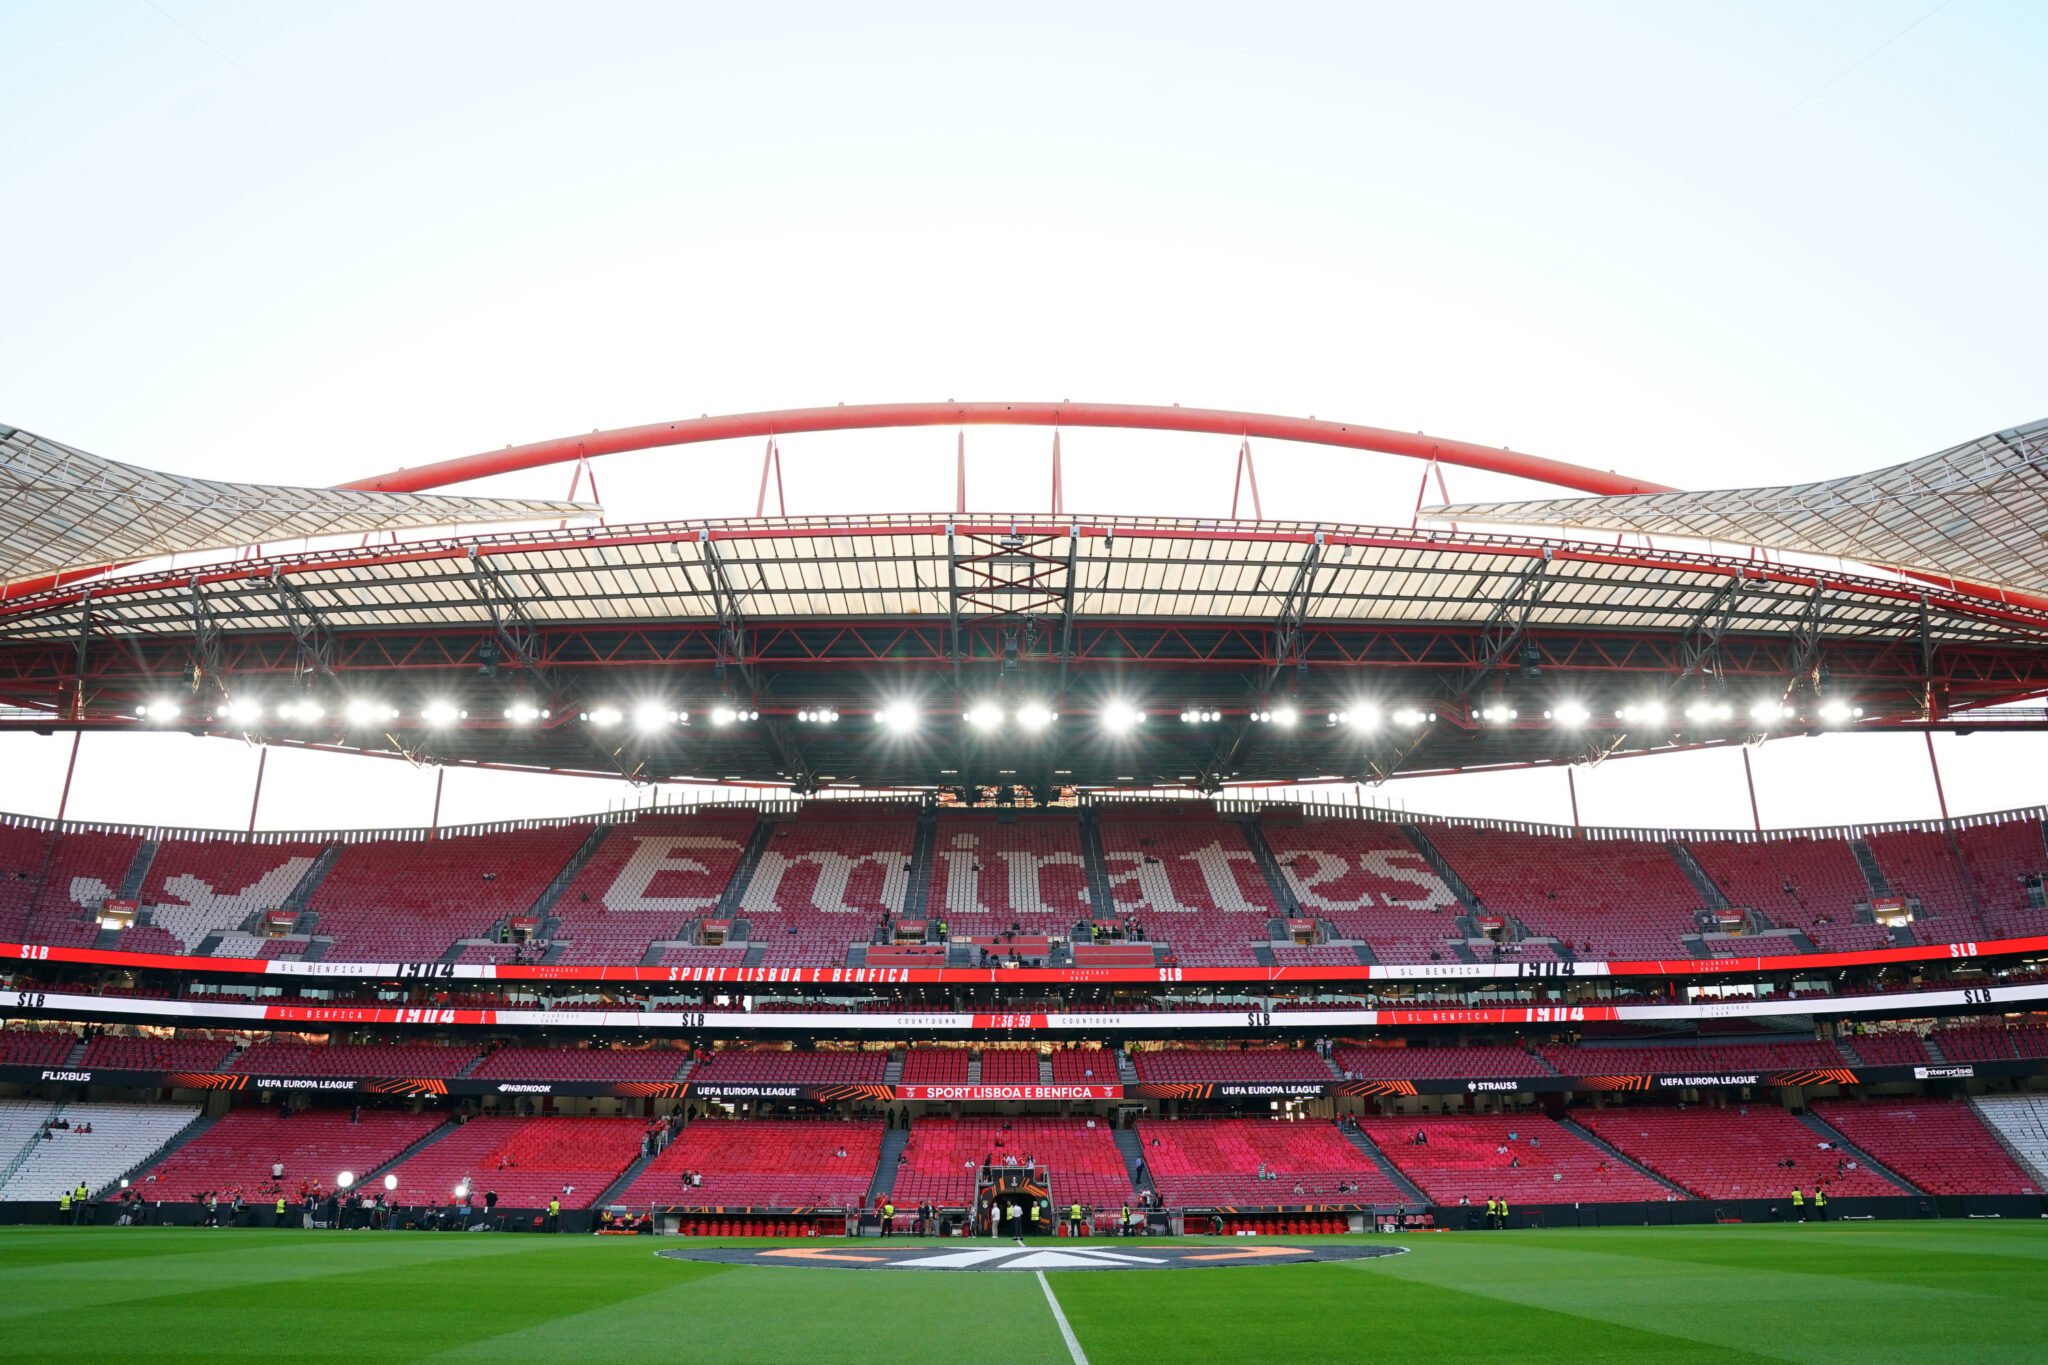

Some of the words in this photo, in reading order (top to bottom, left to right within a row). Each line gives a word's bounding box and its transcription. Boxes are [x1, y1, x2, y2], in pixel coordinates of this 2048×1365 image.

[602, 832, 1457, 913] Emirates
[20, 944, 49, 960] SLB
[1950, 942, 1978, 957] SLB
[281, 963, 295, 972] SL
[308, 964, 364, 974] BENFICA
[669, 967, 727, 981] SPORT
[737, 968, 801, 982] LISBOA
[813, 968, 822, 982] E
[832, 968, 909, 982] BENFICA
[1159, 968, 1183, 981] SLB
[1400, 968, 1413, 976] SL
[1426, 967, 1481, 976] BENFICA
[17, 992, 46, 1007] SLB
[1964, 989, 1992, 1004] SLB
[280, 1008, 294, 1018] SL
[306, 1009, 363, 1019] BENFICA
[682, 1012, 705, 1027] SLB
[1247, 1012, 1271, 1026] SLB
[1408, 1013, 1422, 1022] SL
[1433, 1012, 1489, 1021] BENFICA
[898, 1017, 957, 1025] COUNTDOWN
[990, 1014, 1031, 1028] 1:36:59
[1062, 1017, 1121, 1025] COUNTDOWN
[257, 1079, 282, 1088] UEFA
[283, 1079, 318, 1089] EUROPA
[319, 1080, 355, 1090] LEAGUE
[1478, 1081, 1517, 1091] STRAUSS
[1660, 1077, 1685, 1087] UEFA
[1685, 1077, 1720, 1086] EUROPA
[1720, 1075, 1757, 1085] LEAGUE
[697, 1086, 722, 1095] UEFA
[723, 1086, 760, 1096] EUROPA
[761, 1086, 797, 1097] LEAGUE
[926, 1087, 970, 1099] SPORT
[973, 1087, 1023, 1099] LISBOA
[1025, 1087, 1033, 1099] E
[1037, 1087, 1092, 1099] BENFICA
[1222, 1086, 1247, 1095] UEFA
[1248, 1086, 1285, 1096] EUROPA
[1285, 1085, 1322, 1095] LEAGUE
